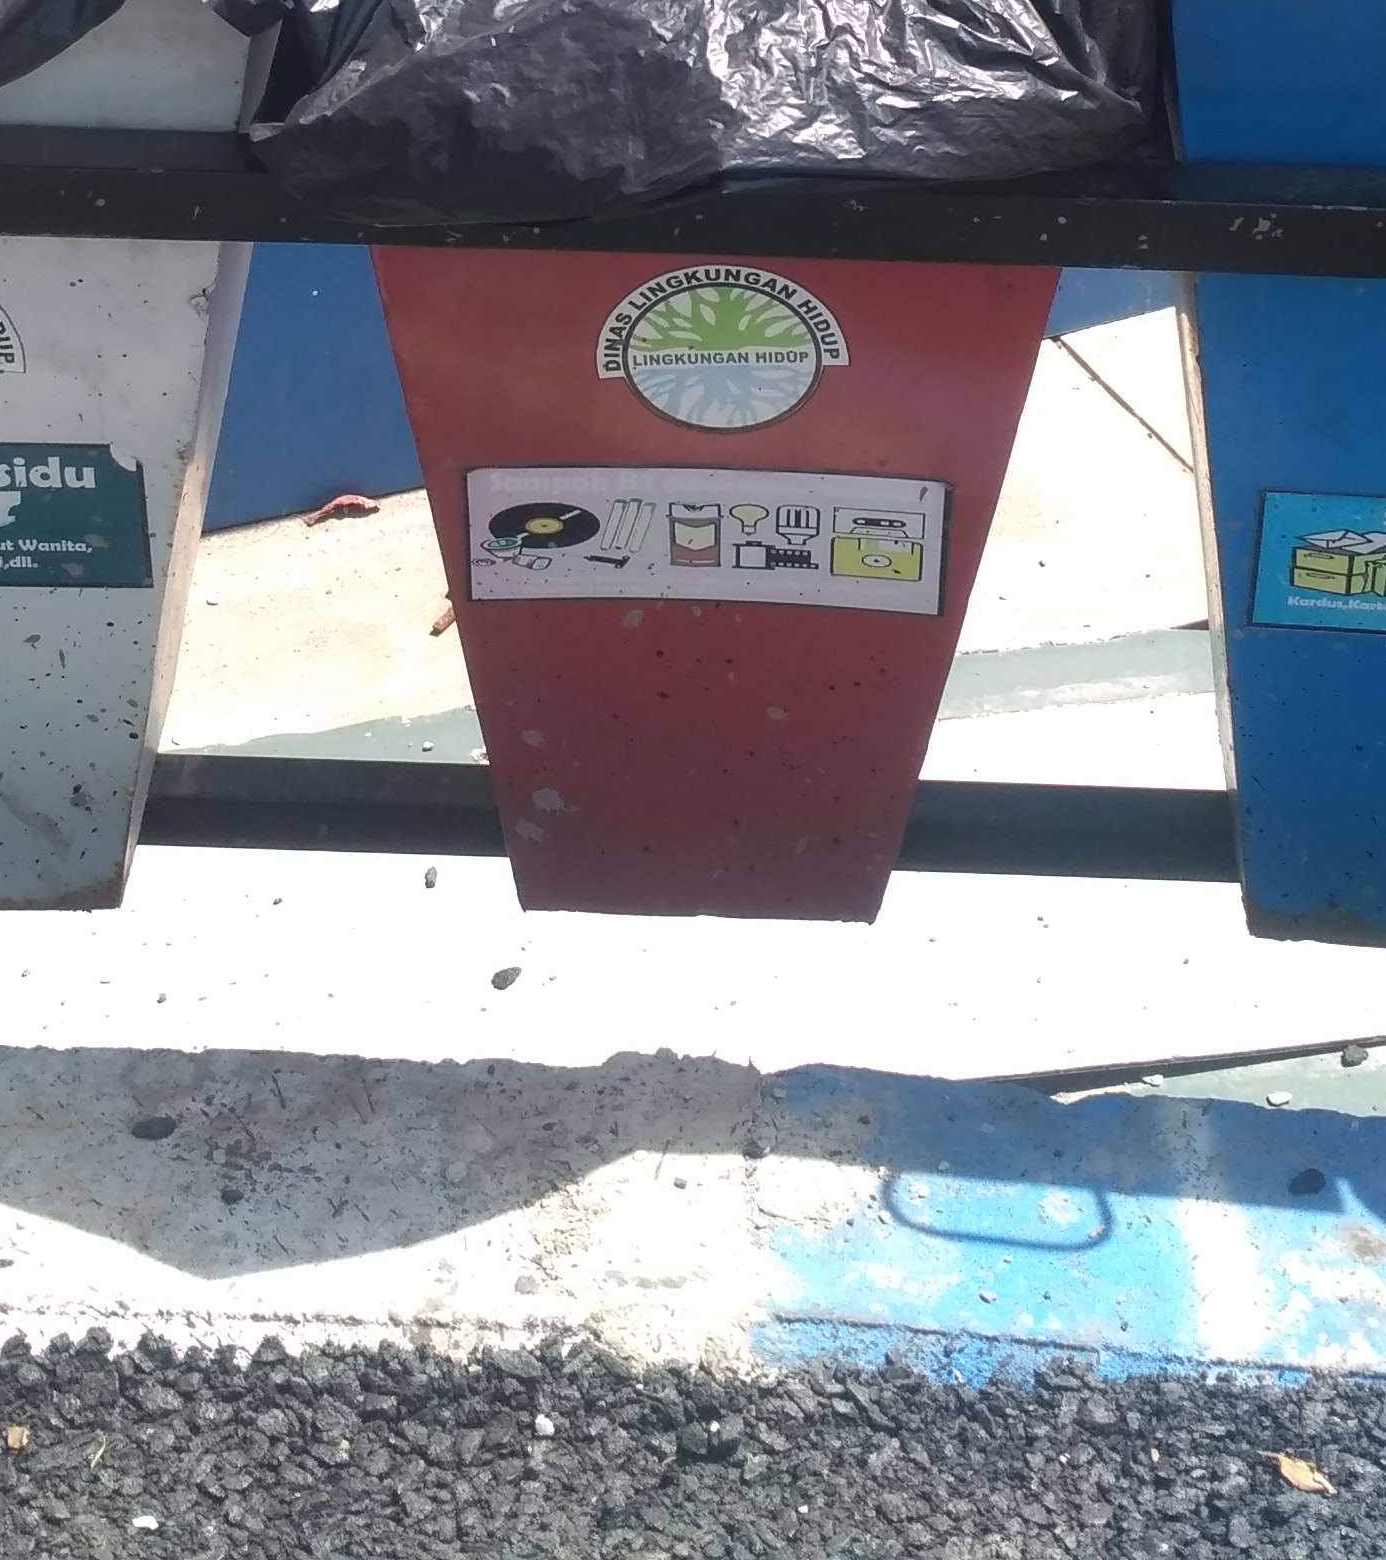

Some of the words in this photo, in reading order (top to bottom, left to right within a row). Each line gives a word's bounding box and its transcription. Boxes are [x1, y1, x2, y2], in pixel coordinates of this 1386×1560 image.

[604, 311, 633, 371] DINAS
[631, 268, 797, 312] LINGKUNGAN
[797, 298, 840, 360] HIDUP
[633, 351, 750, 366] LINGKUNGAN
[756, 350, 809, 365] HIDUP
[18, 539, 93, 554] Wanita,
